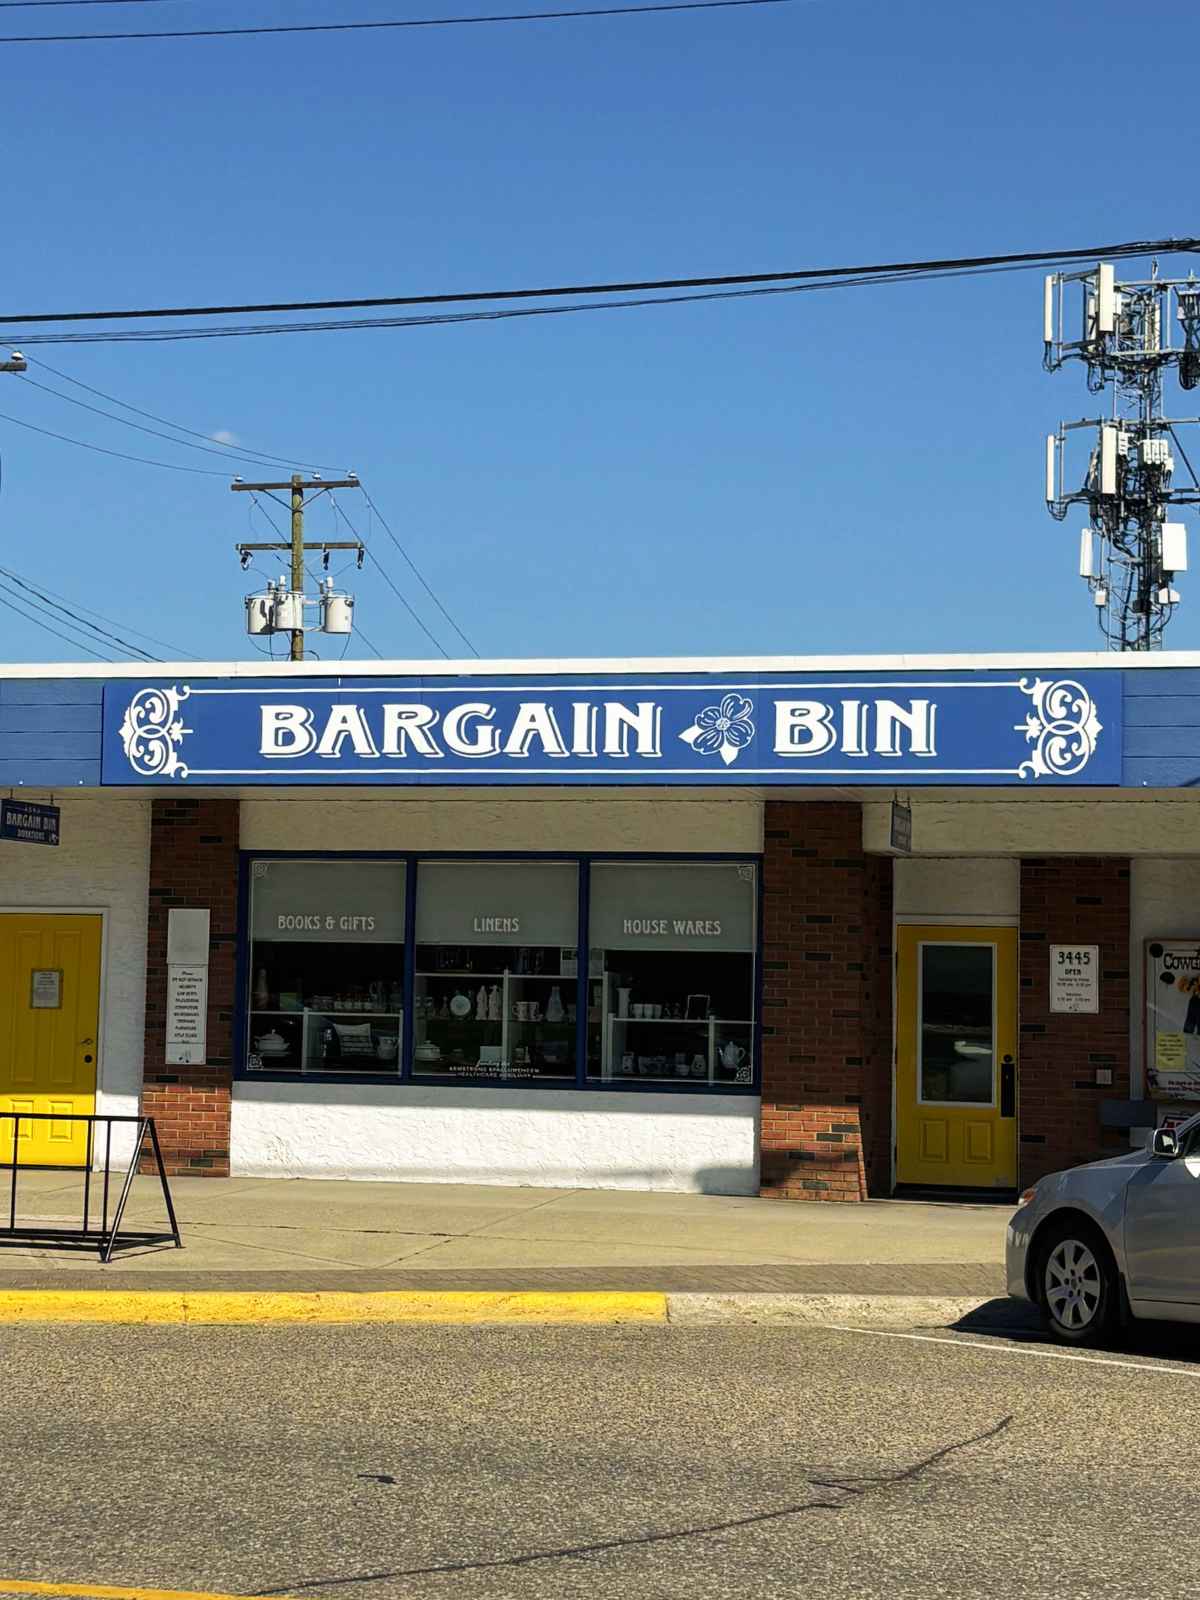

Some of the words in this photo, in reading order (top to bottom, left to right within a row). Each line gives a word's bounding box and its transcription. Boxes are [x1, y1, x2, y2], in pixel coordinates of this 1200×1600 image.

[258, 700, 664, 759] BARGAIN
[773, 698, 938, 758] BIN
[6, 812, 41, 829] BARGAIN
[278, 915, 320, 930] BOOKS
[325, 916, 337, 930] &
[340, 916, 376, 931] GIFTS
[474, 917, 519, 932] LINENS
[623, 919, 669, 934] HOUSE
[672, 920, 722, 936] WARES
[1057, 951, 1090, 965] 3445
[1064, 968, 1082, 976] OPEN
